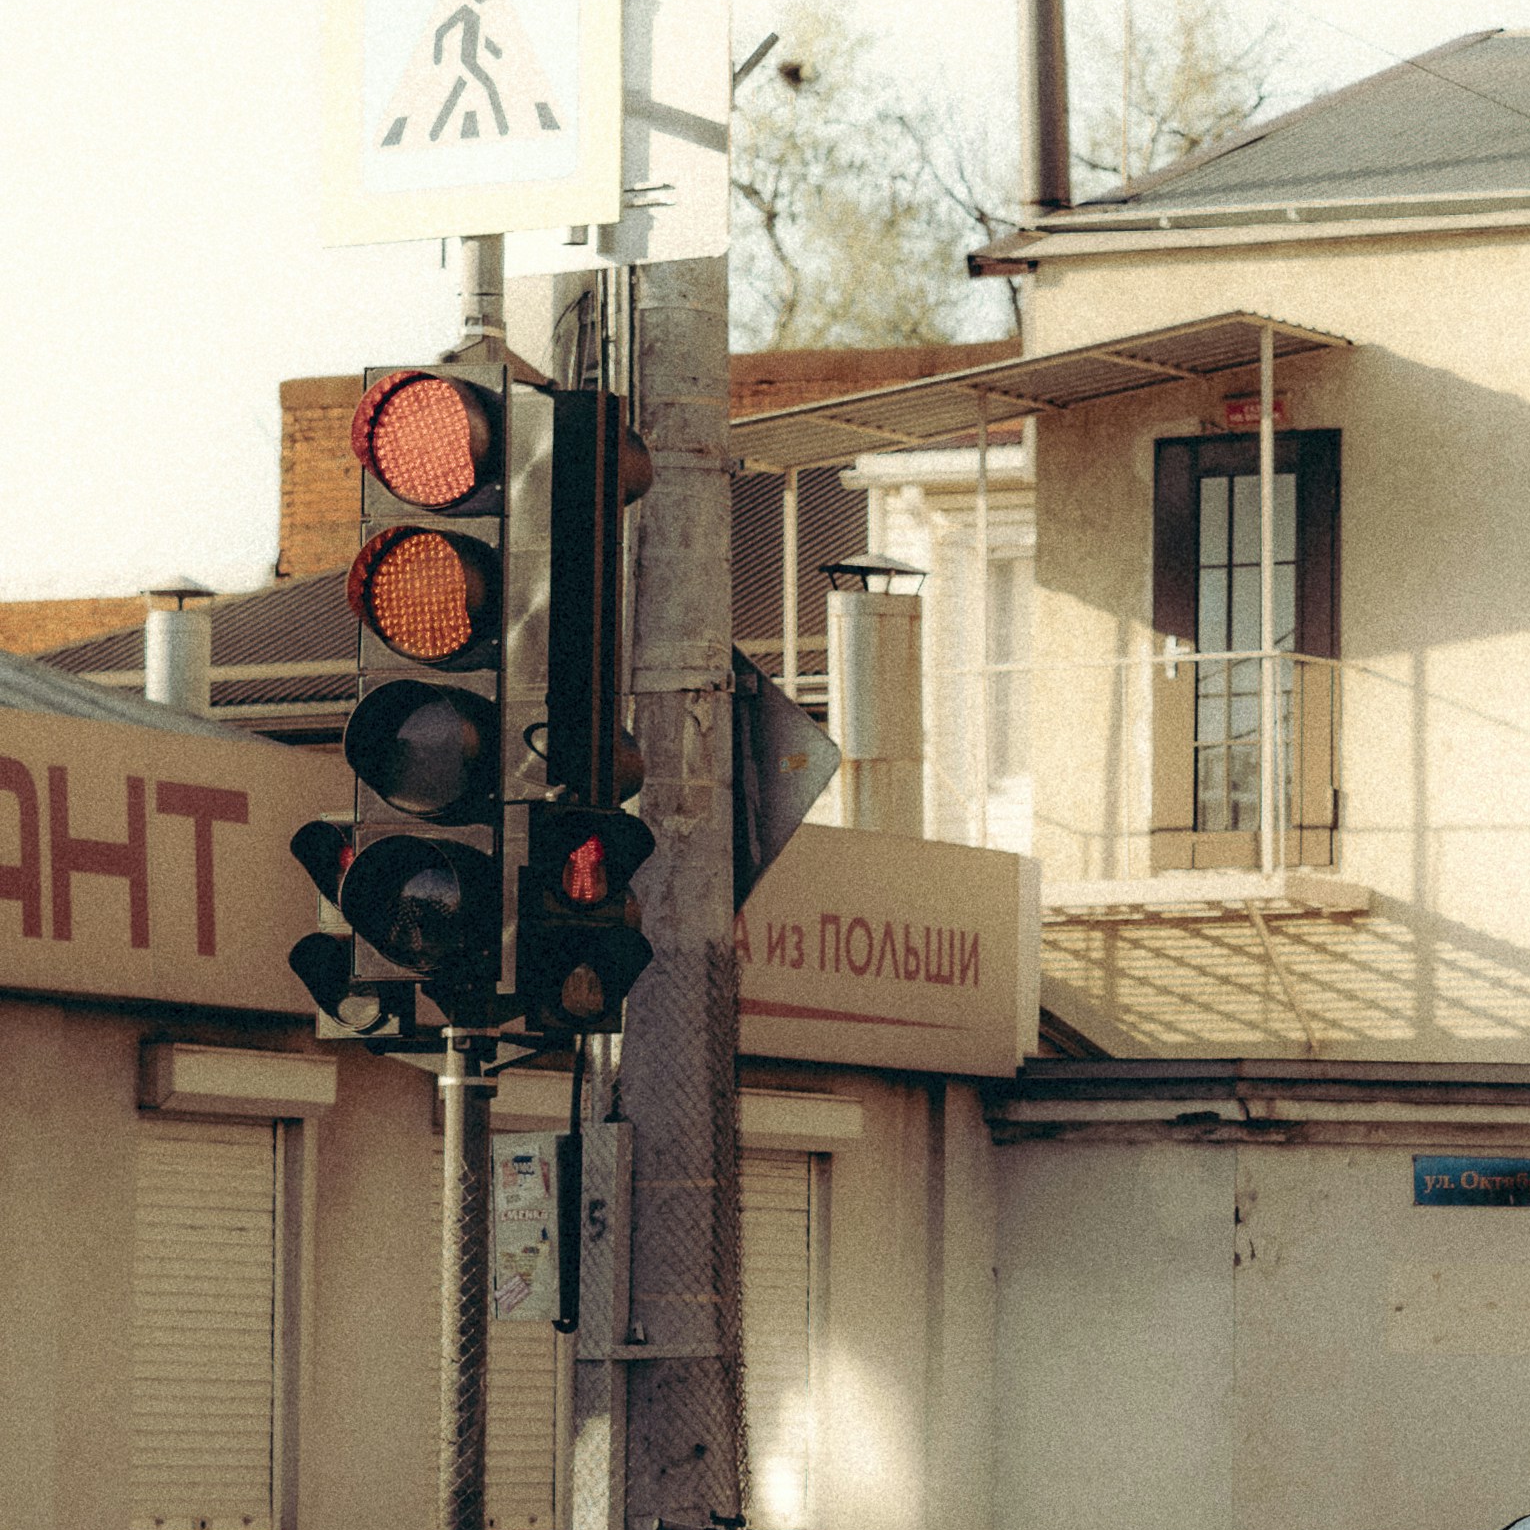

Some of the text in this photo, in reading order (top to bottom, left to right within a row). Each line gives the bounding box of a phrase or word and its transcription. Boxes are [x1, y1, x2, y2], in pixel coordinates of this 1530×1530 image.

[767, 922, 804, 969] из
[819, 913, 980, 987] ПОЛЬШИ
[1424, 1174, 1455, 1194] ул.
